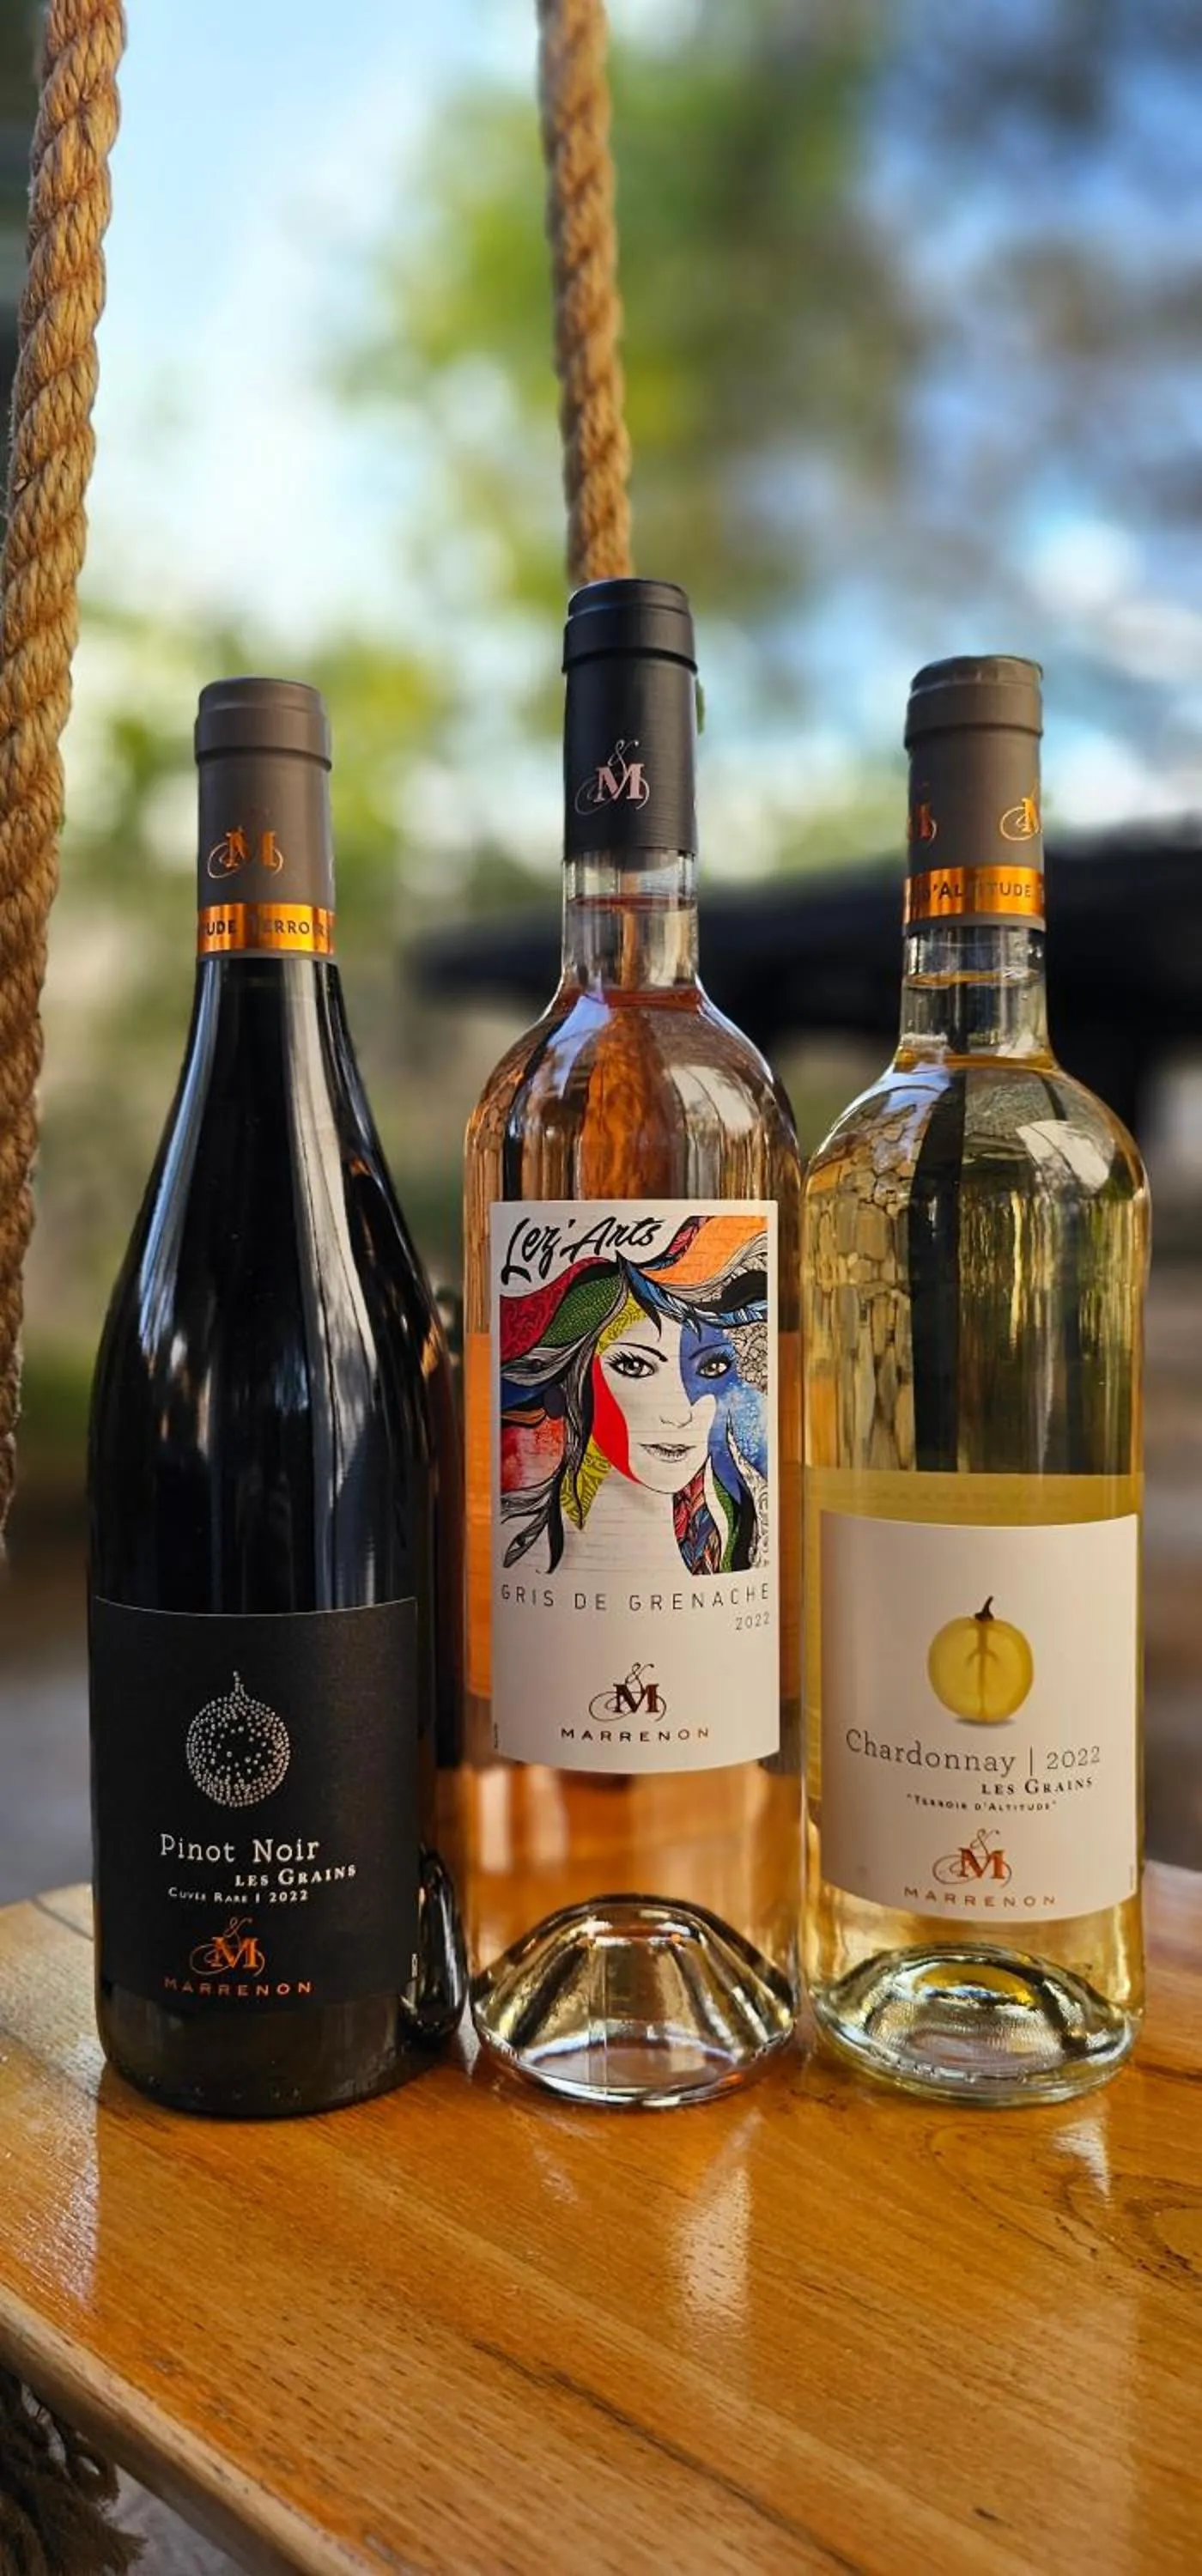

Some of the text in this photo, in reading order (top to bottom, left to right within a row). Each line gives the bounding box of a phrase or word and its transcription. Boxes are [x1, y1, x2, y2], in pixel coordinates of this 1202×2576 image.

[501, 1583, 770, 1612] GRIS DE GRENACHE
[735, 1611, 771, 1631] 2022
[561, 1728, 709, 1743] MARRENON
[846, 1728, 1017, 1778] Chardonnay
[1046, 1745, 1102, 1771] 2022
[981, 1783, 1015, 1795] LES
[160, 1833, 321, 1862] Pinot Noir
[234, 1874, 270, 1887] LES
[269, 1890, 309, 1903] 2022
[904, 1886, 1056, 1908] MARRENON
[164, 1978, 313, 1996] MARRENON
